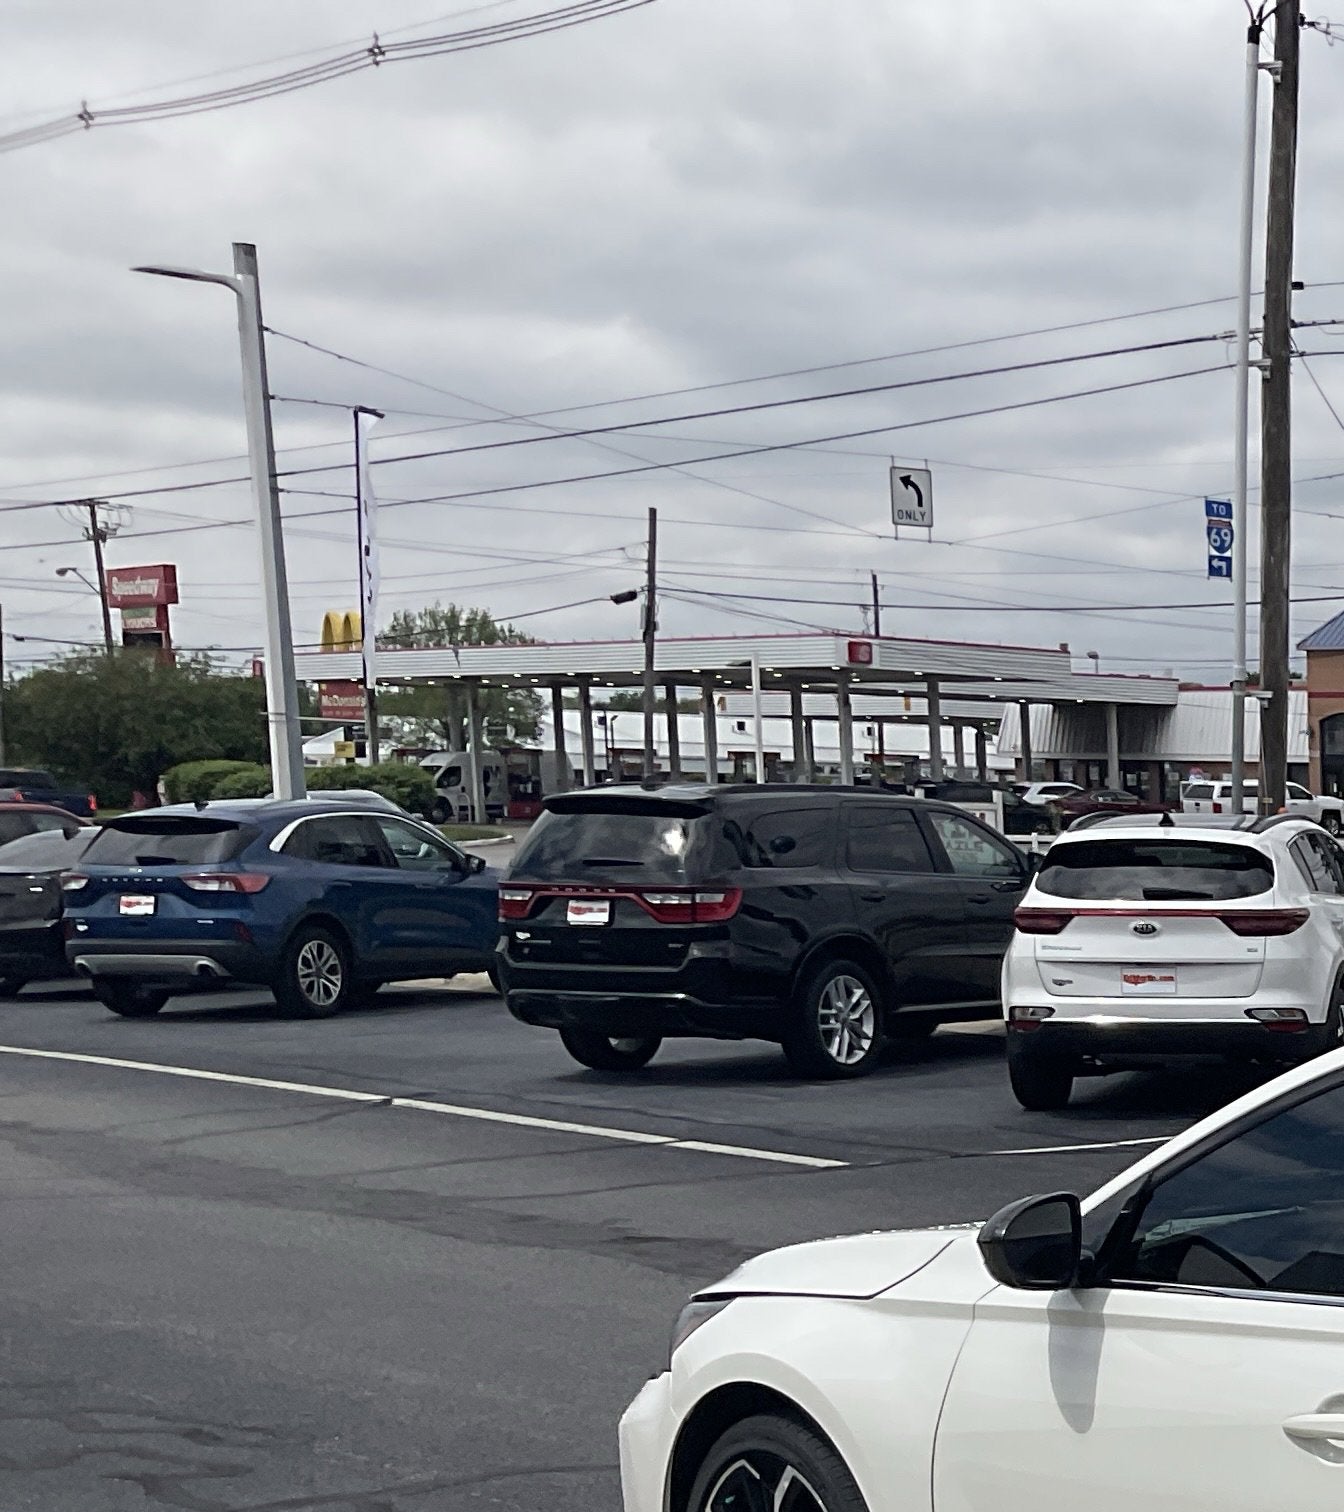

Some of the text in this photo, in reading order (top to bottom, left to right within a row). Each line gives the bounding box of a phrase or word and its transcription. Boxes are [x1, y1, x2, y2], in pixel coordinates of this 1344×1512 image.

[897, 509, 926, 521] ONLY
[1211, 503, 1226, 515] TO
[1210, 528, 1231, 547] 69
[111, 575, 159, 601] Speedway
